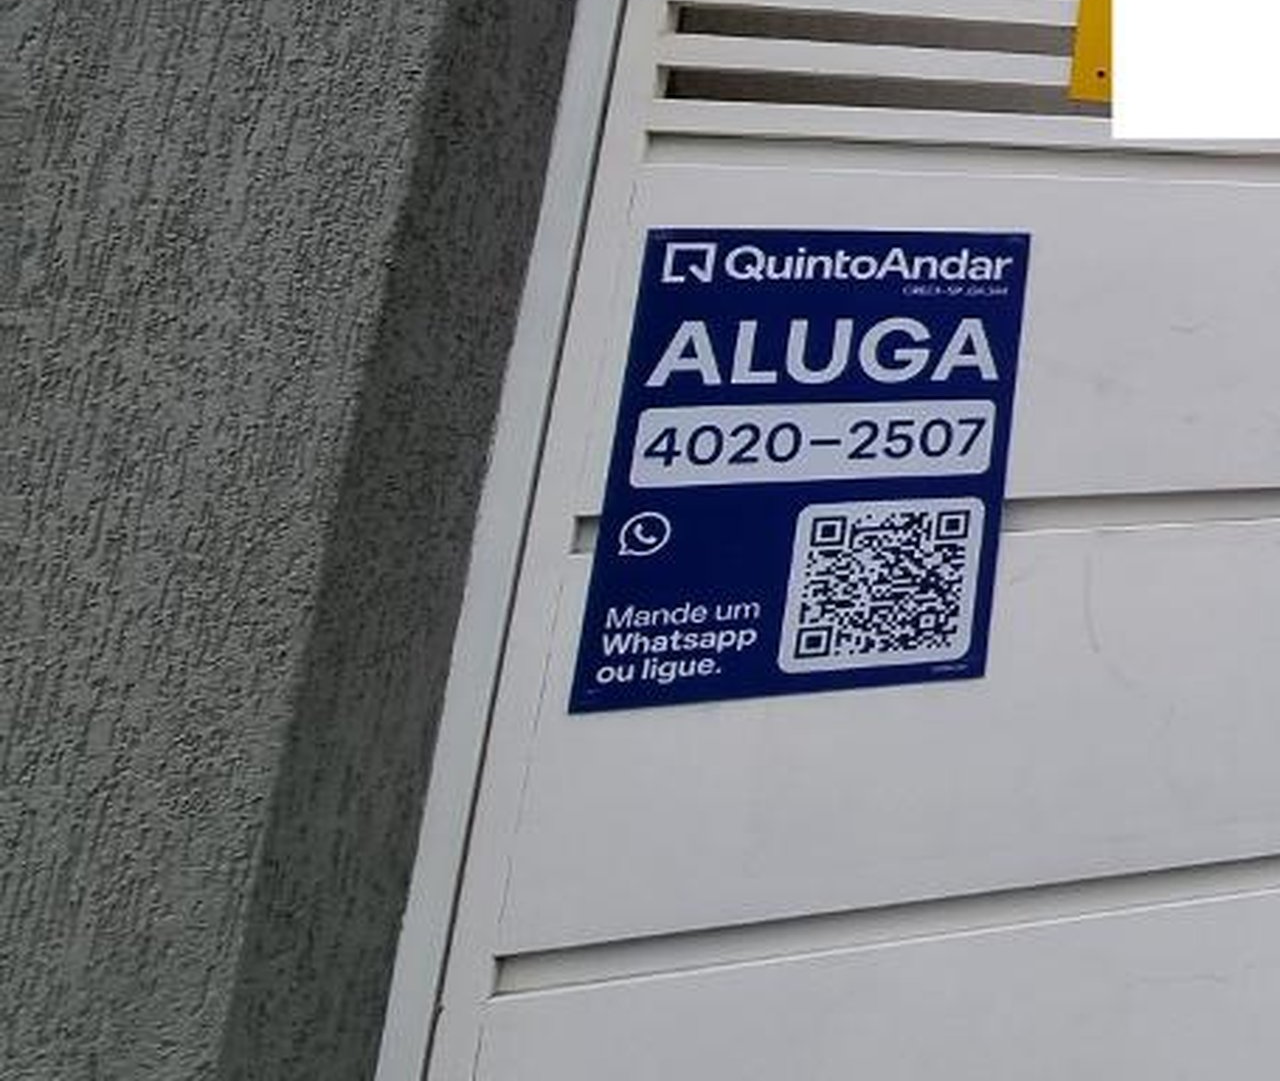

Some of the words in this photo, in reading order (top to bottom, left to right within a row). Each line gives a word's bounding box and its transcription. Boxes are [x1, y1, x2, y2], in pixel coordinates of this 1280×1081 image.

[724, 245, 1014, 282] QuintoAndar
[644, 317, 999, 387] ALUGA
[643, 417, 988, 467] 4020-2507
[605, 601, 708, 629] Mande
[715, 602, 761, 621] um
[602, 628, 758, 657] Whatsapp
[596, 664, 635, 684] ou
[641, 657, 722, 685] ligue.
